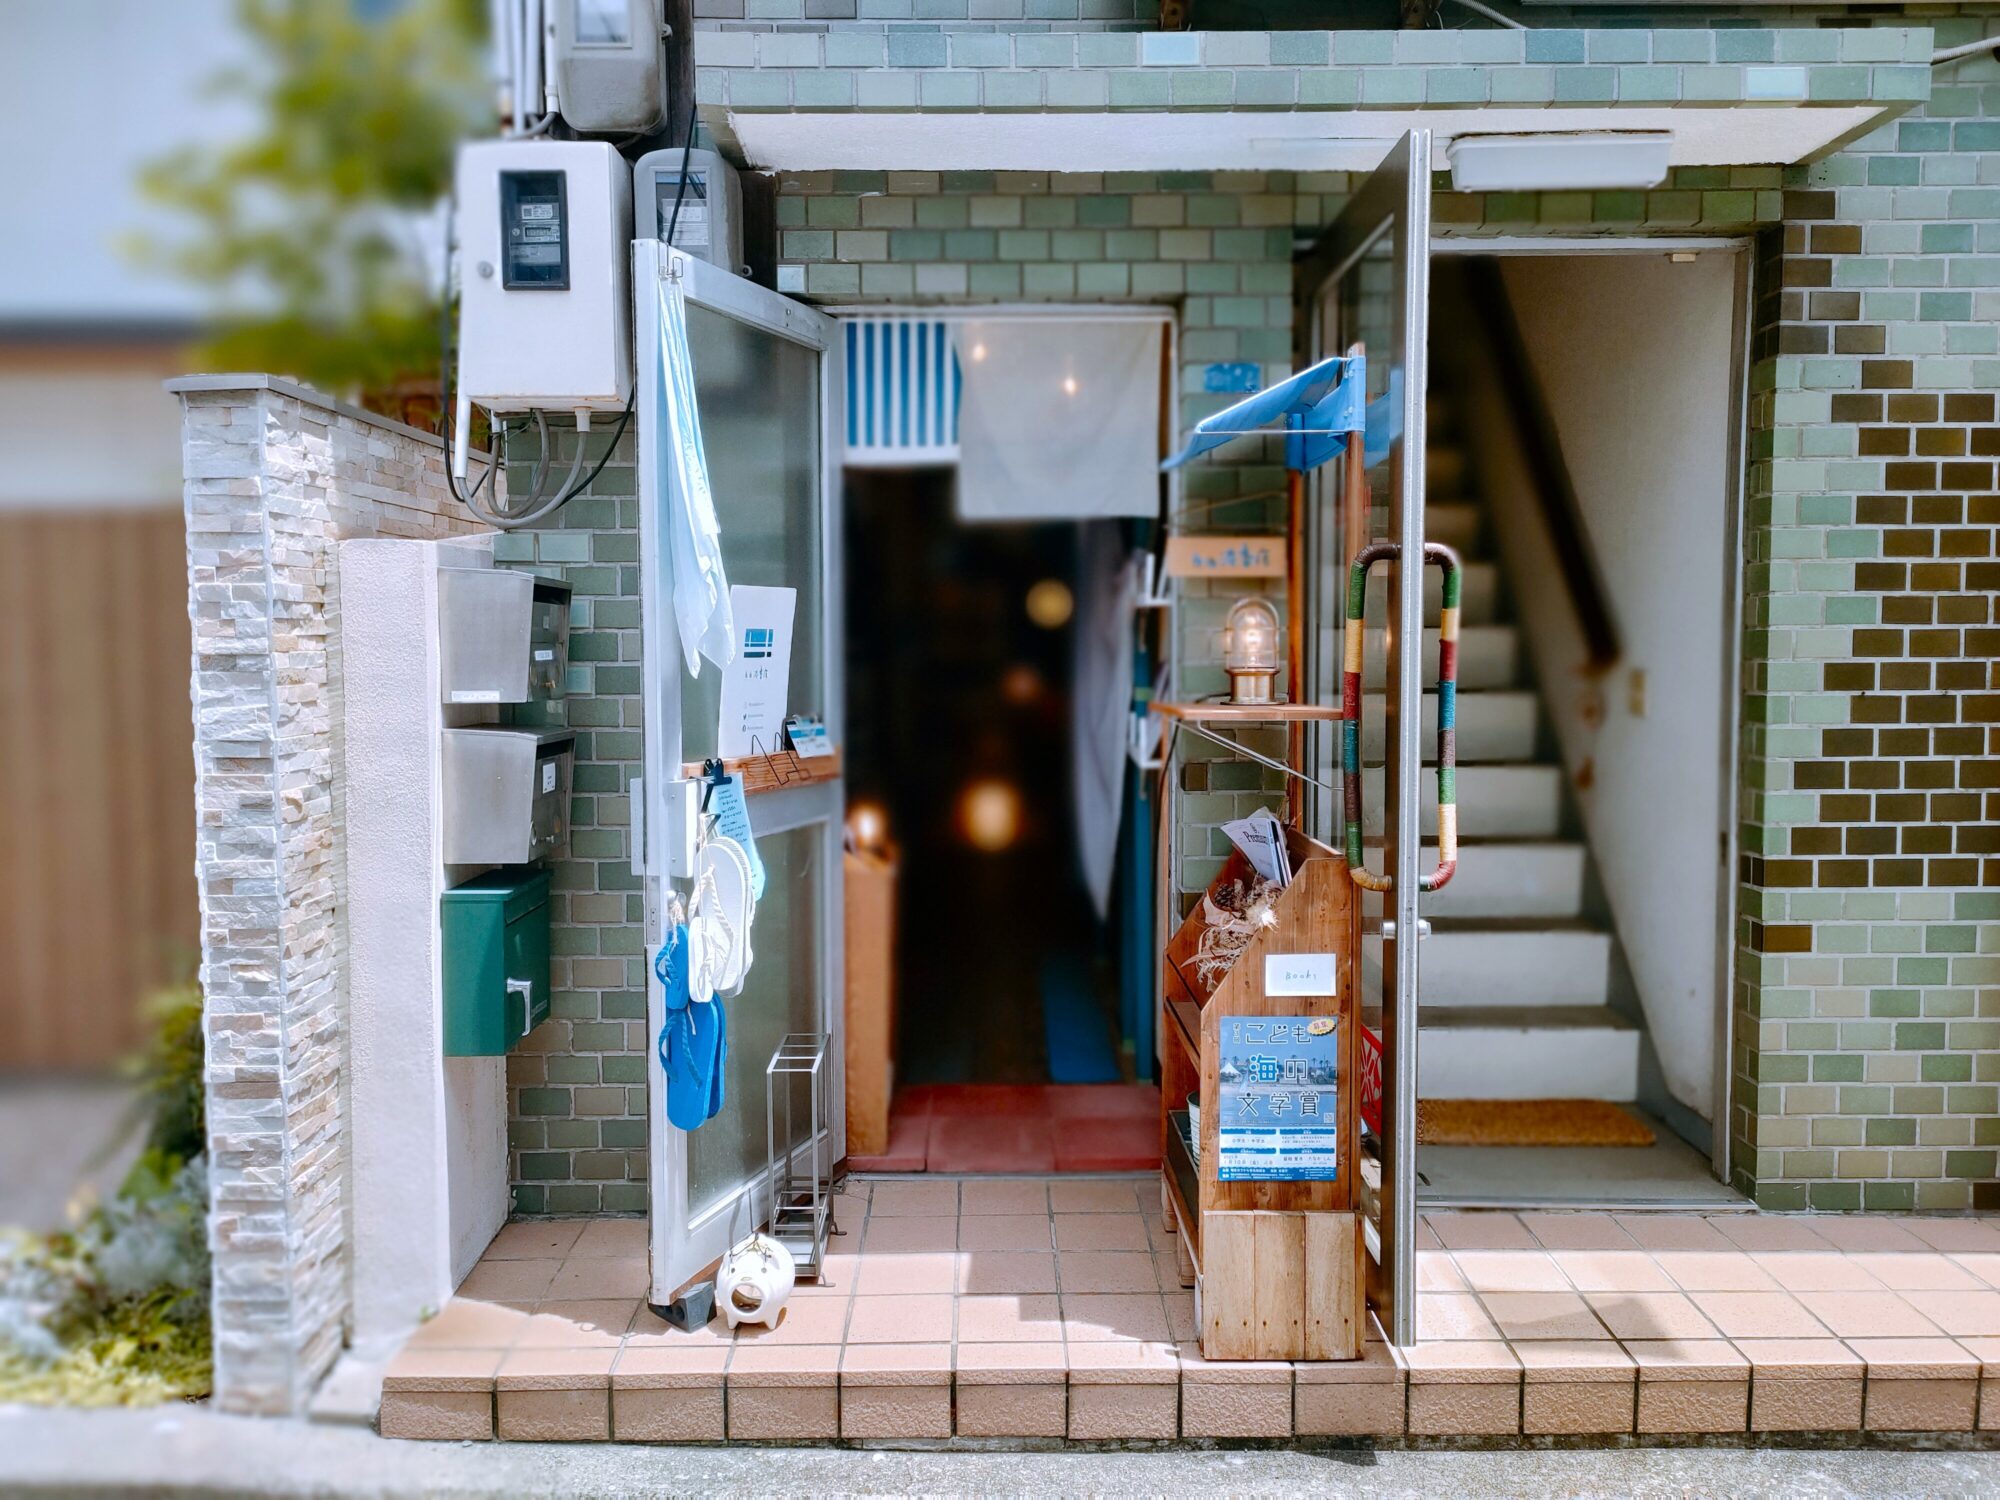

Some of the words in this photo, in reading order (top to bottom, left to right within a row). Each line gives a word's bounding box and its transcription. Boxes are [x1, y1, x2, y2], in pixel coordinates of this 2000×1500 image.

[1246, 1023, 1312, 1044] こども
[1249, 1054, 1309, 1083] 海の
[1239, 1091, 1320, 1117] 文学賞
